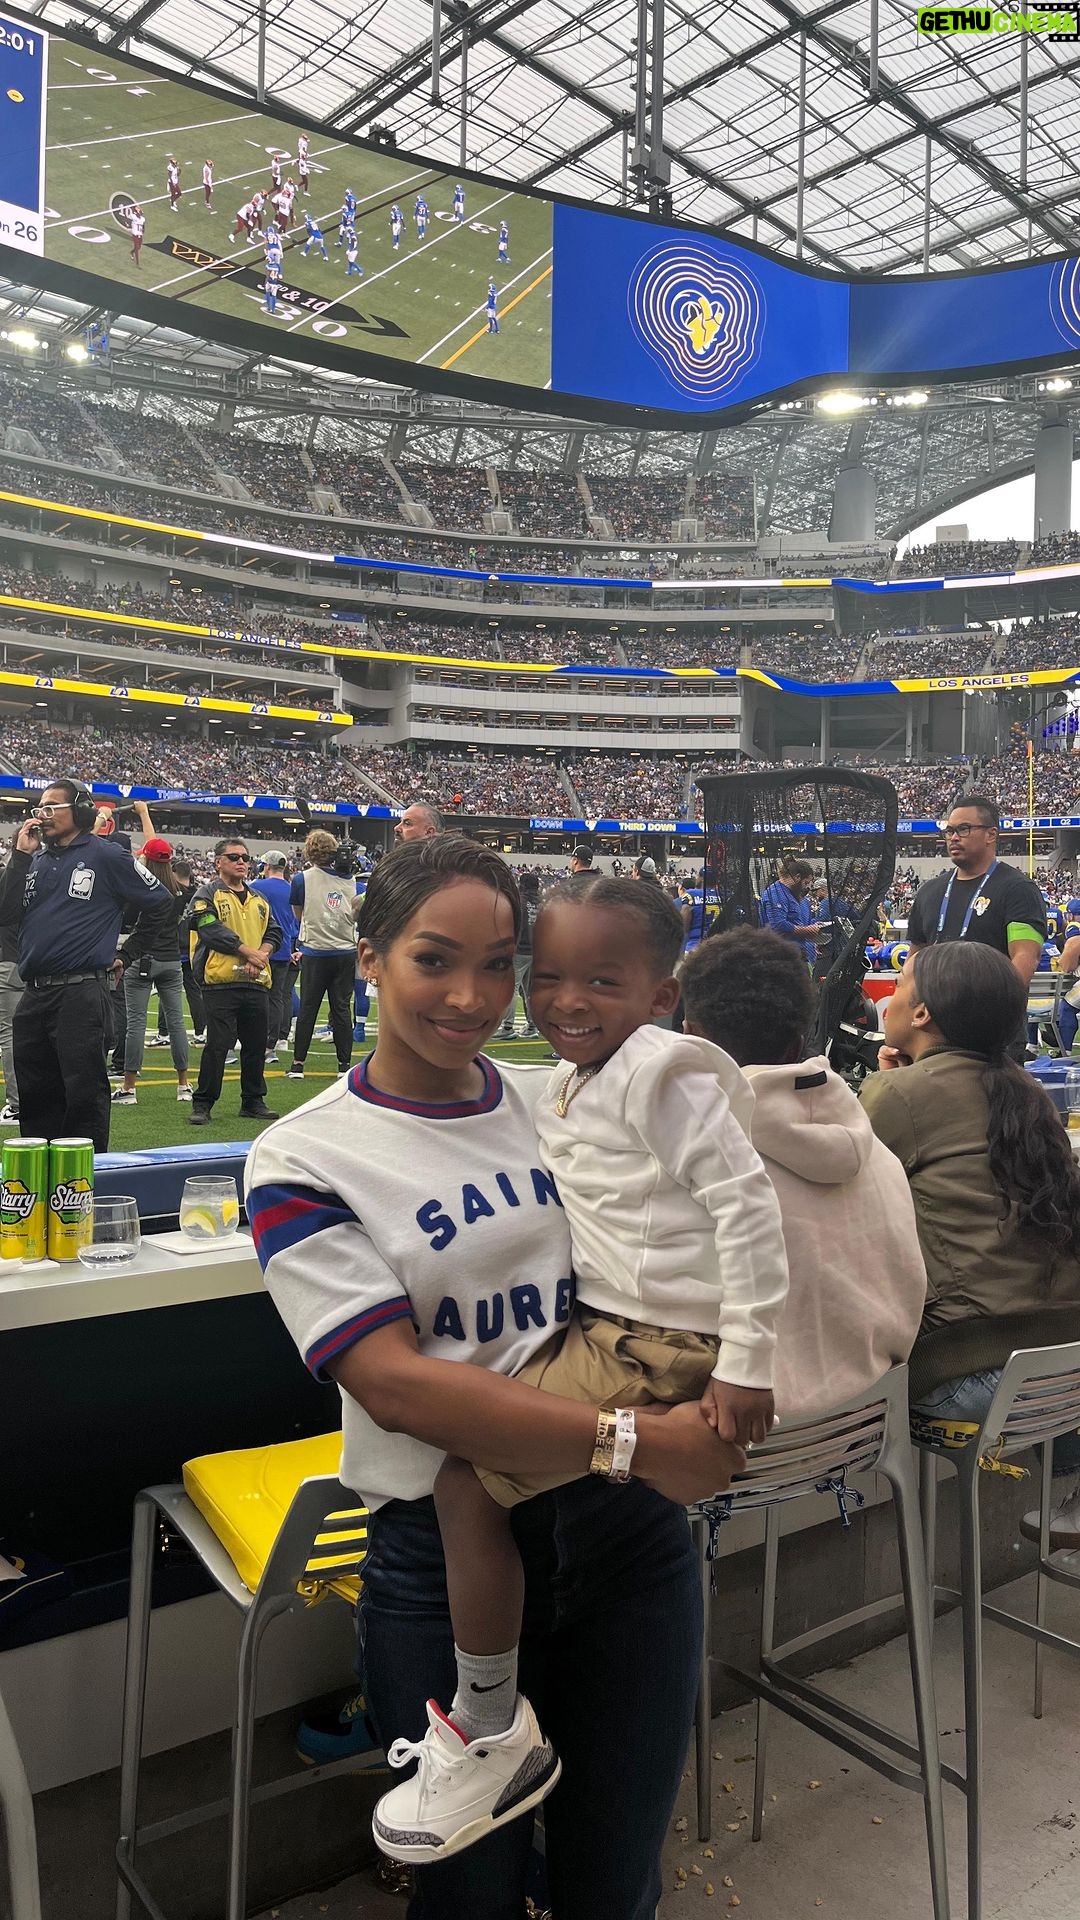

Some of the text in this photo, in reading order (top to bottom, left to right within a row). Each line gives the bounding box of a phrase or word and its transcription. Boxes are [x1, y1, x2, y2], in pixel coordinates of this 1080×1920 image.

[14, 220, 38, 242] 26
[209, 628, 302, 648] LOS ANGELES
[929, 674, 1030, 688] LOS ANGELES
[307, 802, 337, 813] DOWN
[534, 819, 564, 829] DOWN
[618, 822, 677, 832] THIRD DOWN
[1060, 818, 1071, 826] Q2
[416, 1168, 564, 1251] SAIN
[413, 1278, 572, 1344] AURE
